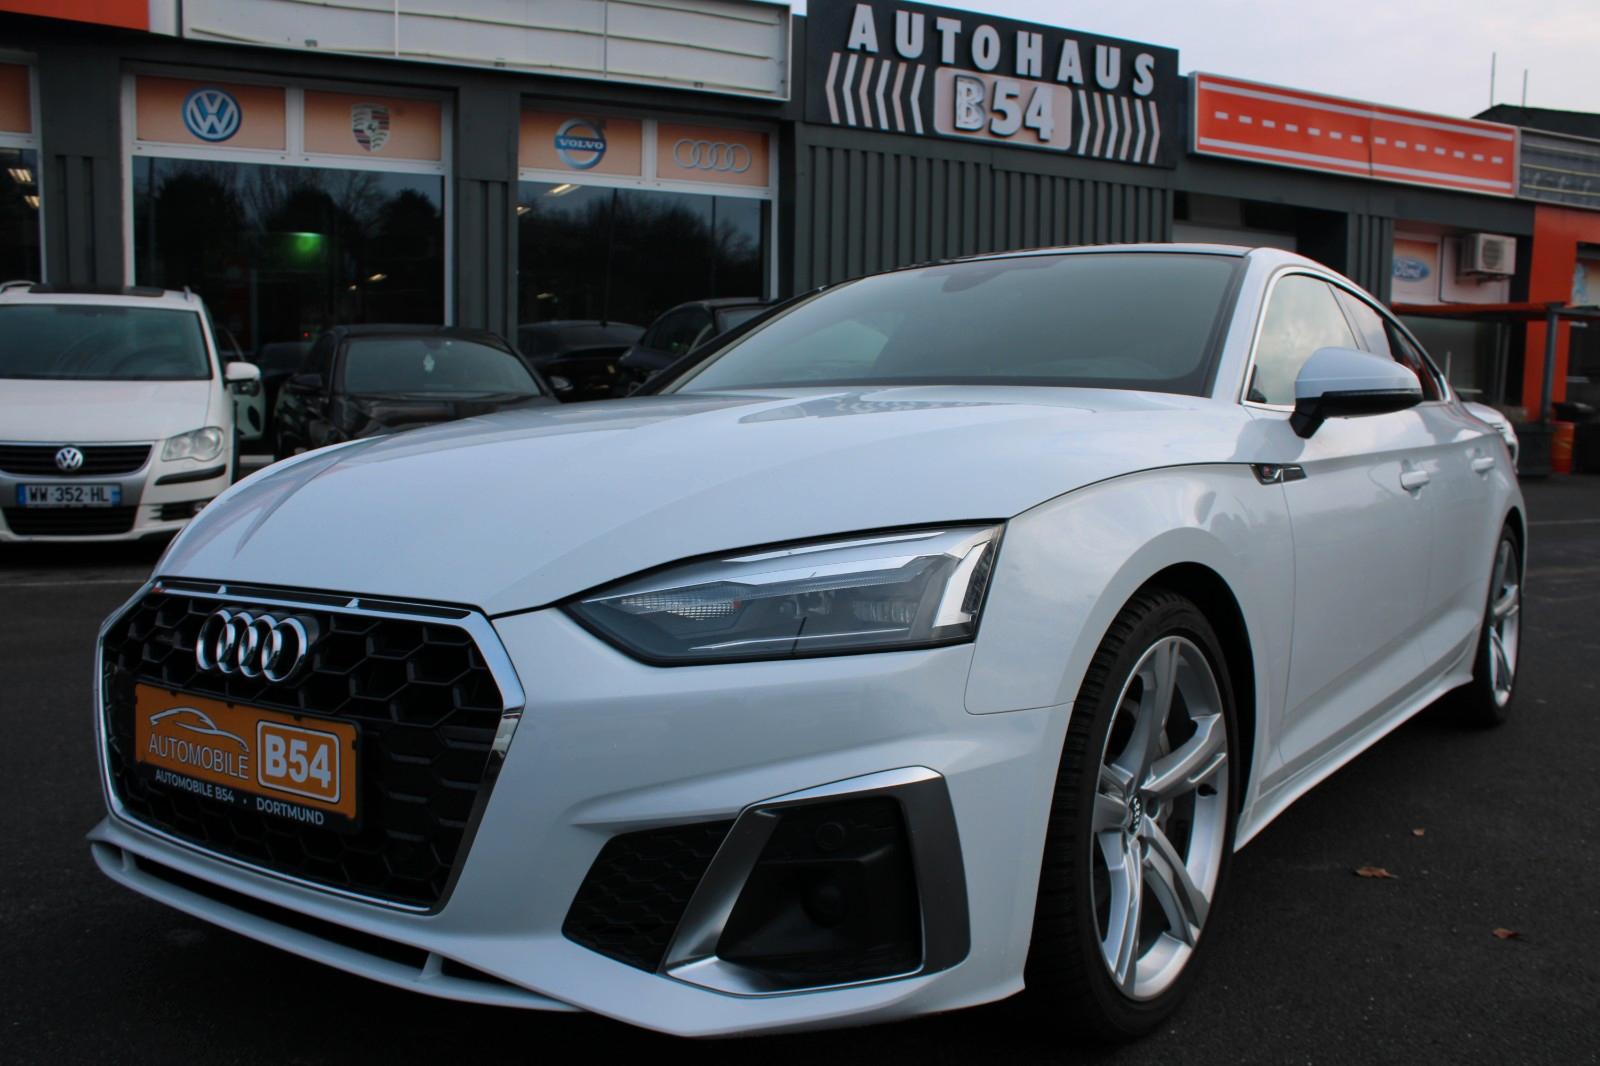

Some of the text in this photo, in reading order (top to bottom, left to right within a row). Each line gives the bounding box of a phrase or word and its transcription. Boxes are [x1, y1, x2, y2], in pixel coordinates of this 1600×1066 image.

[847, 3, 1155, 97] AUTOHAUS
[953, 74, 1054, 141] B54
[559, 138, 605, 151] VOLVO
[148, 733, 249, 780] AUTOMOBILE
[264, 733, 332, 788] B54
[154, 769, 325, 826] AUTOMOBILE B54 DORTMUND
